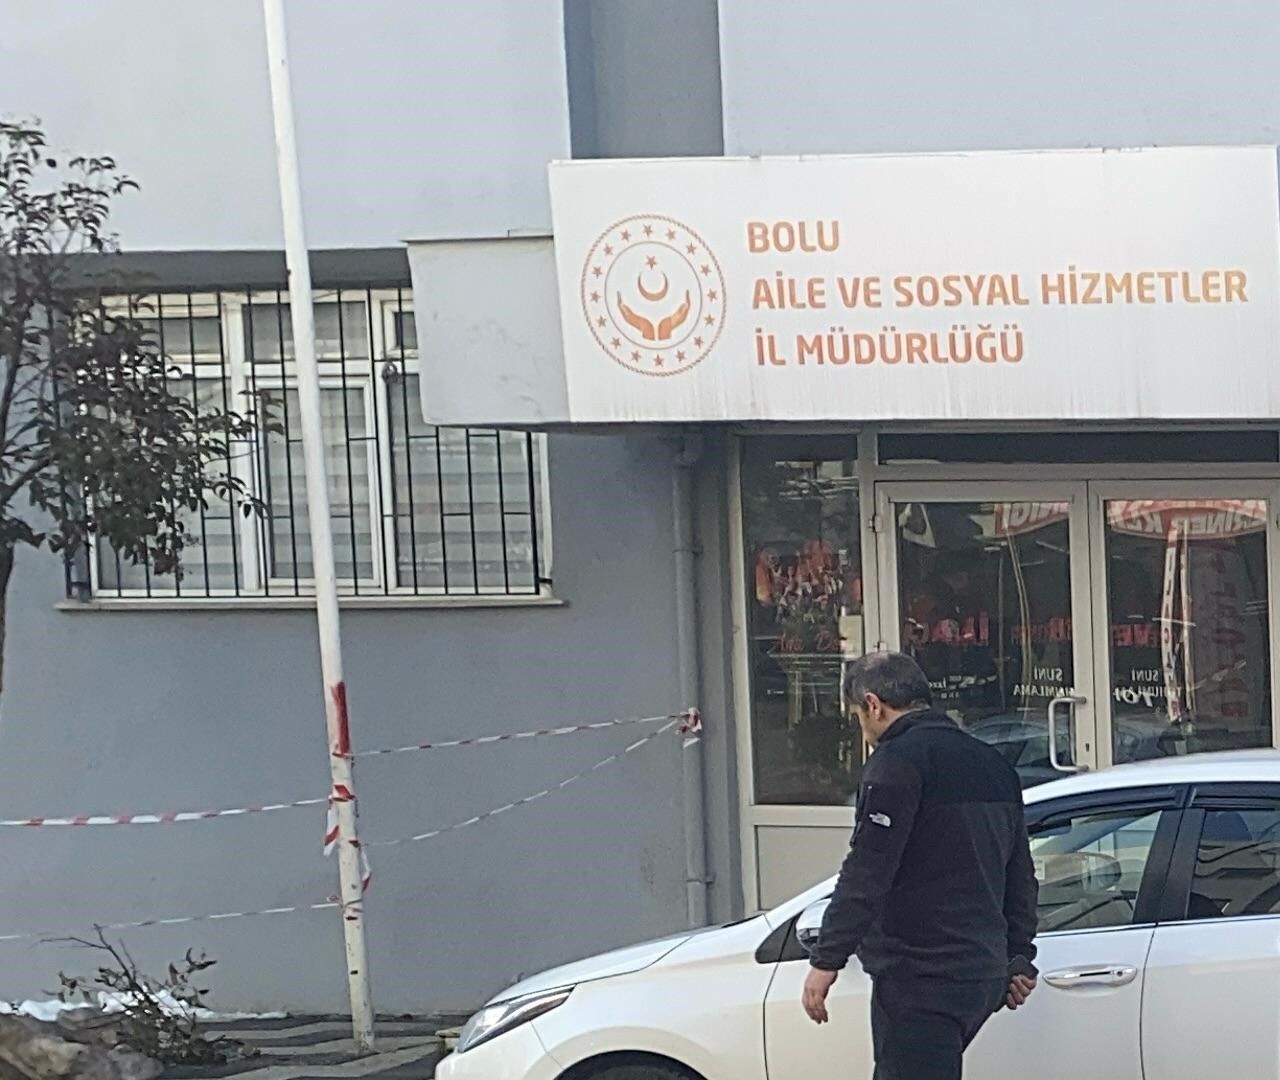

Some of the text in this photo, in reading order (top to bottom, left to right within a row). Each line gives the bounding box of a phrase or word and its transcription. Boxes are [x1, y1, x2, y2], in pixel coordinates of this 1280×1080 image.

[747, 219, 840, 255] BOLU
[752, 264, 1249, 312] AİLE VE SOSYAL HİZMETLER
[755, 322, 1025, 368] İL MÜDÜRLÜĞÜ
